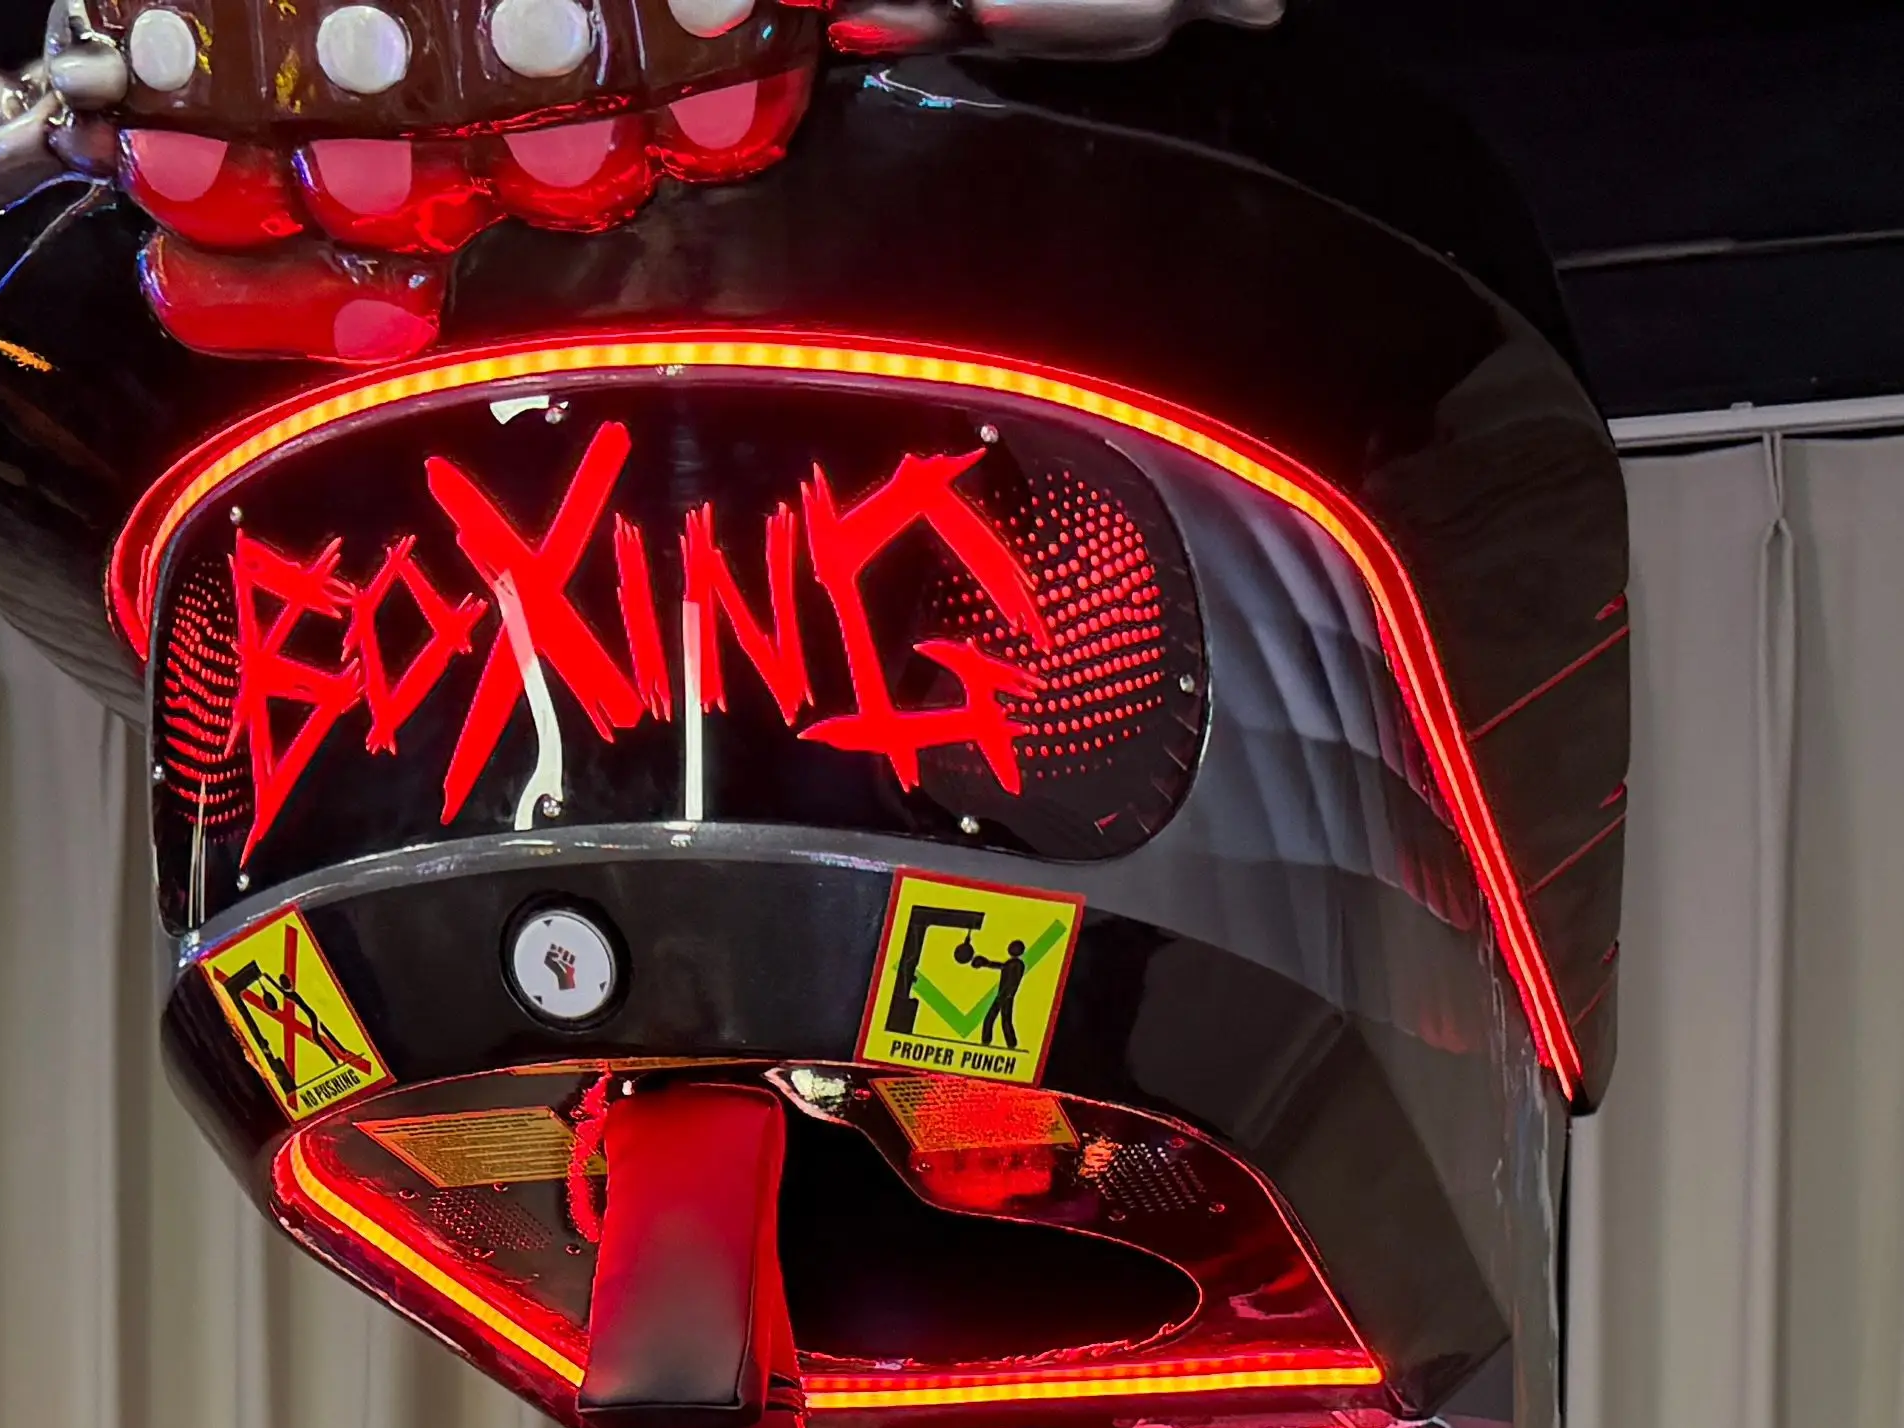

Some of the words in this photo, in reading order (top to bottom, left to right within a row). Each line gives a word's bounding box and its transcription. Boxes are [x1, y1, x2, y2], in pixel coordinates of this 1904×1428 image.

[226, 422, 1052, 868] BOXING
[889, 1040, 955, 1066] PROPER
[961, 1051, 1017, 1075] PUNCH
[299, 1089, 317, 1109] NO
[316, 1068, 362, 1104] PUSHING
